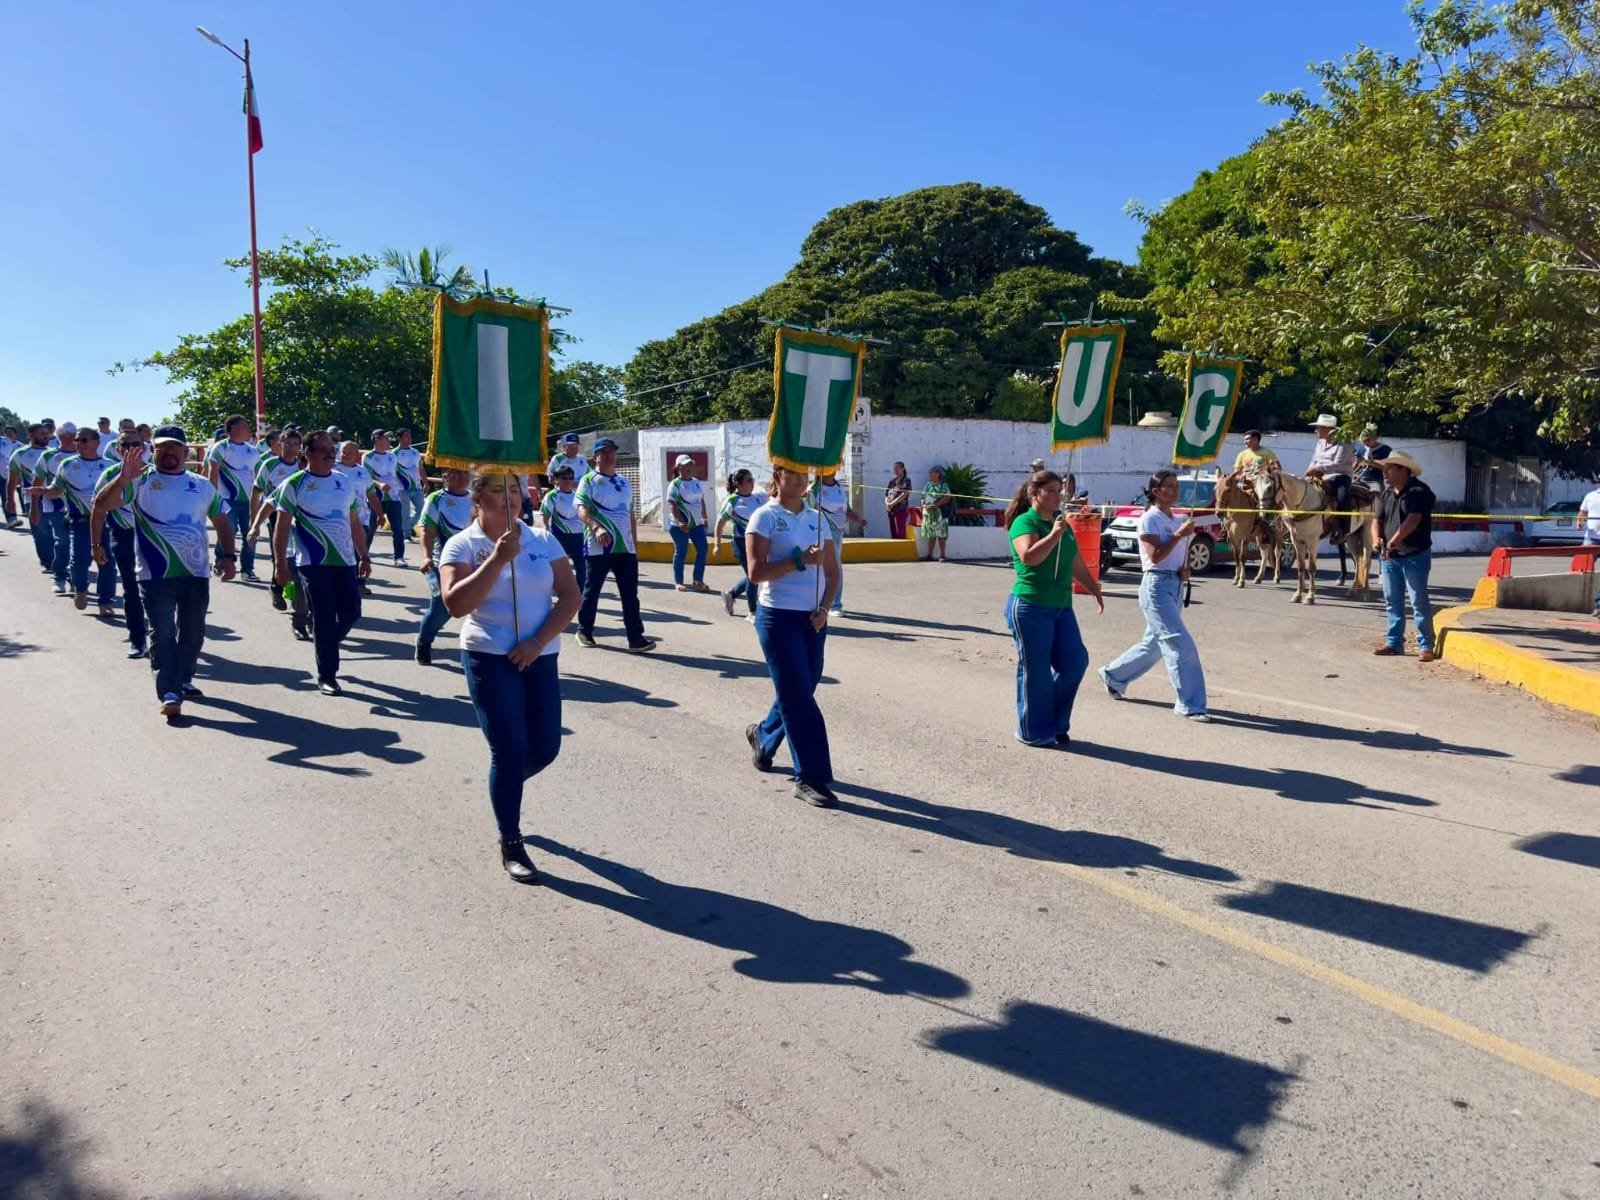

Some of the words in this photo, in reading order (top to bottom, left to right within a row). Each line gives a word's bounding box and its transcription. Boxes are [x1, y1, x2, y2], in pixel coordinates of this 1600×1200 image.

[477, 323, 513, 441] I
[785, 348, 852, 448] T
[1057, 340, 1112, 427] U
[1182, 373, 1230, 447] G
